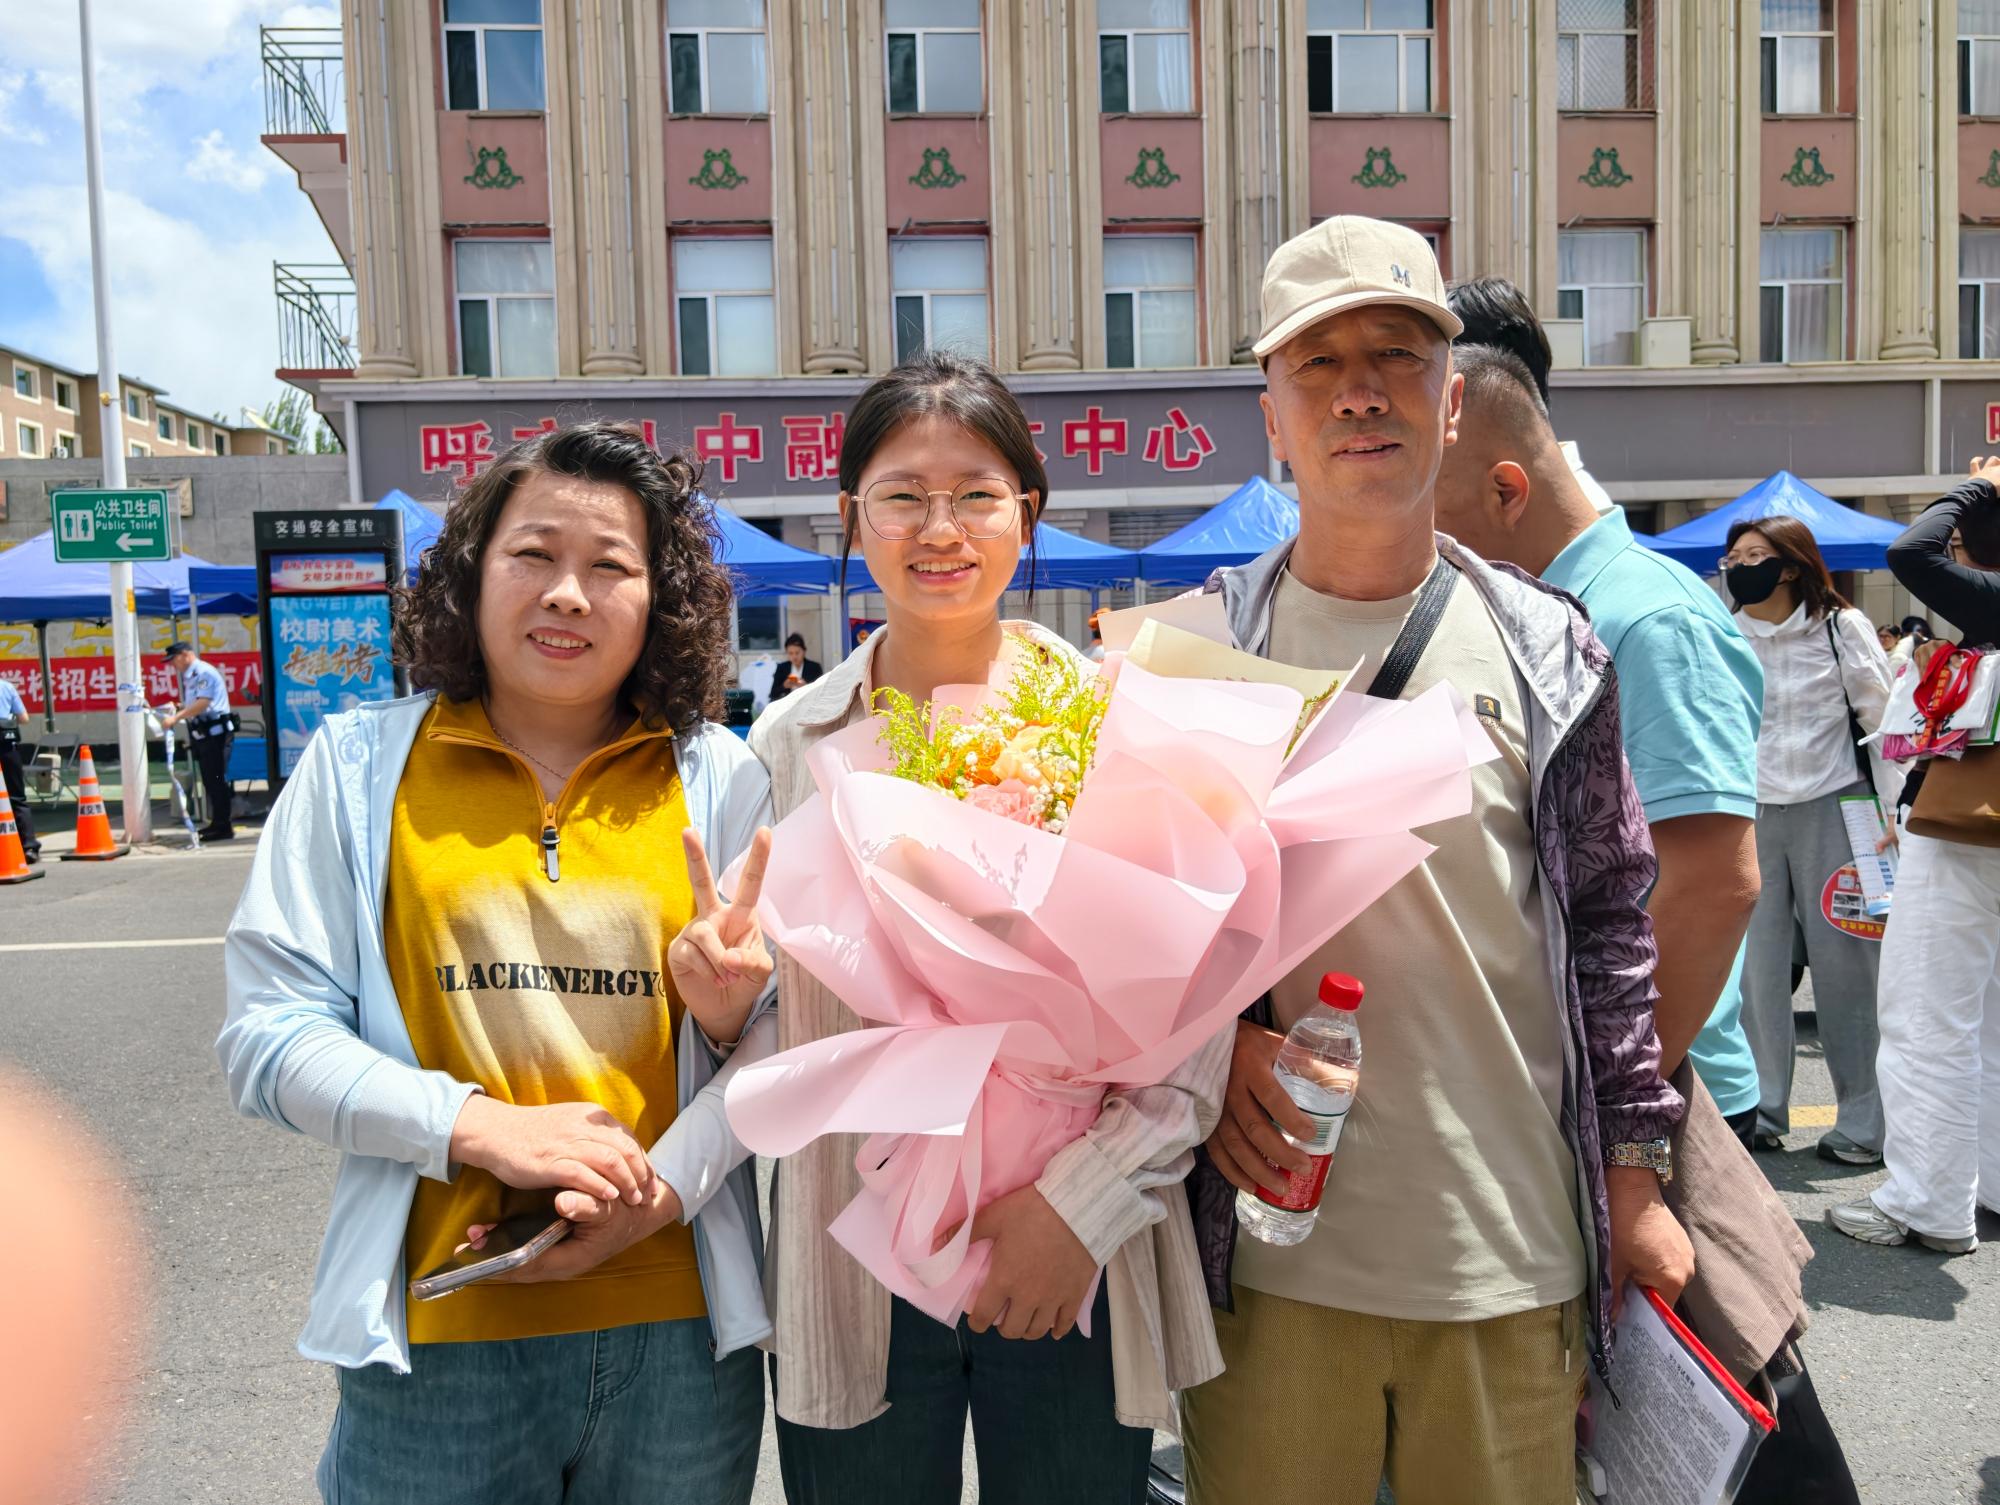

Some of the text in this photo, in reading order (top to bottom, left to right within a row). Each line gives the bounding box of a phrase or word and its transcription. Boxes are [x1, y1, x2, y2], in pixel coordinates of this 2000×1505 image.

[421, 406, 1216, 489] 呼中融中心
[95, 499, 161, 518] 公共卫生间
[95, 520, 157, 530] Public Toilet
[274, 518, 375, 535] 交通安全宣传
[280, 617, 382, 643] 校尉美术
